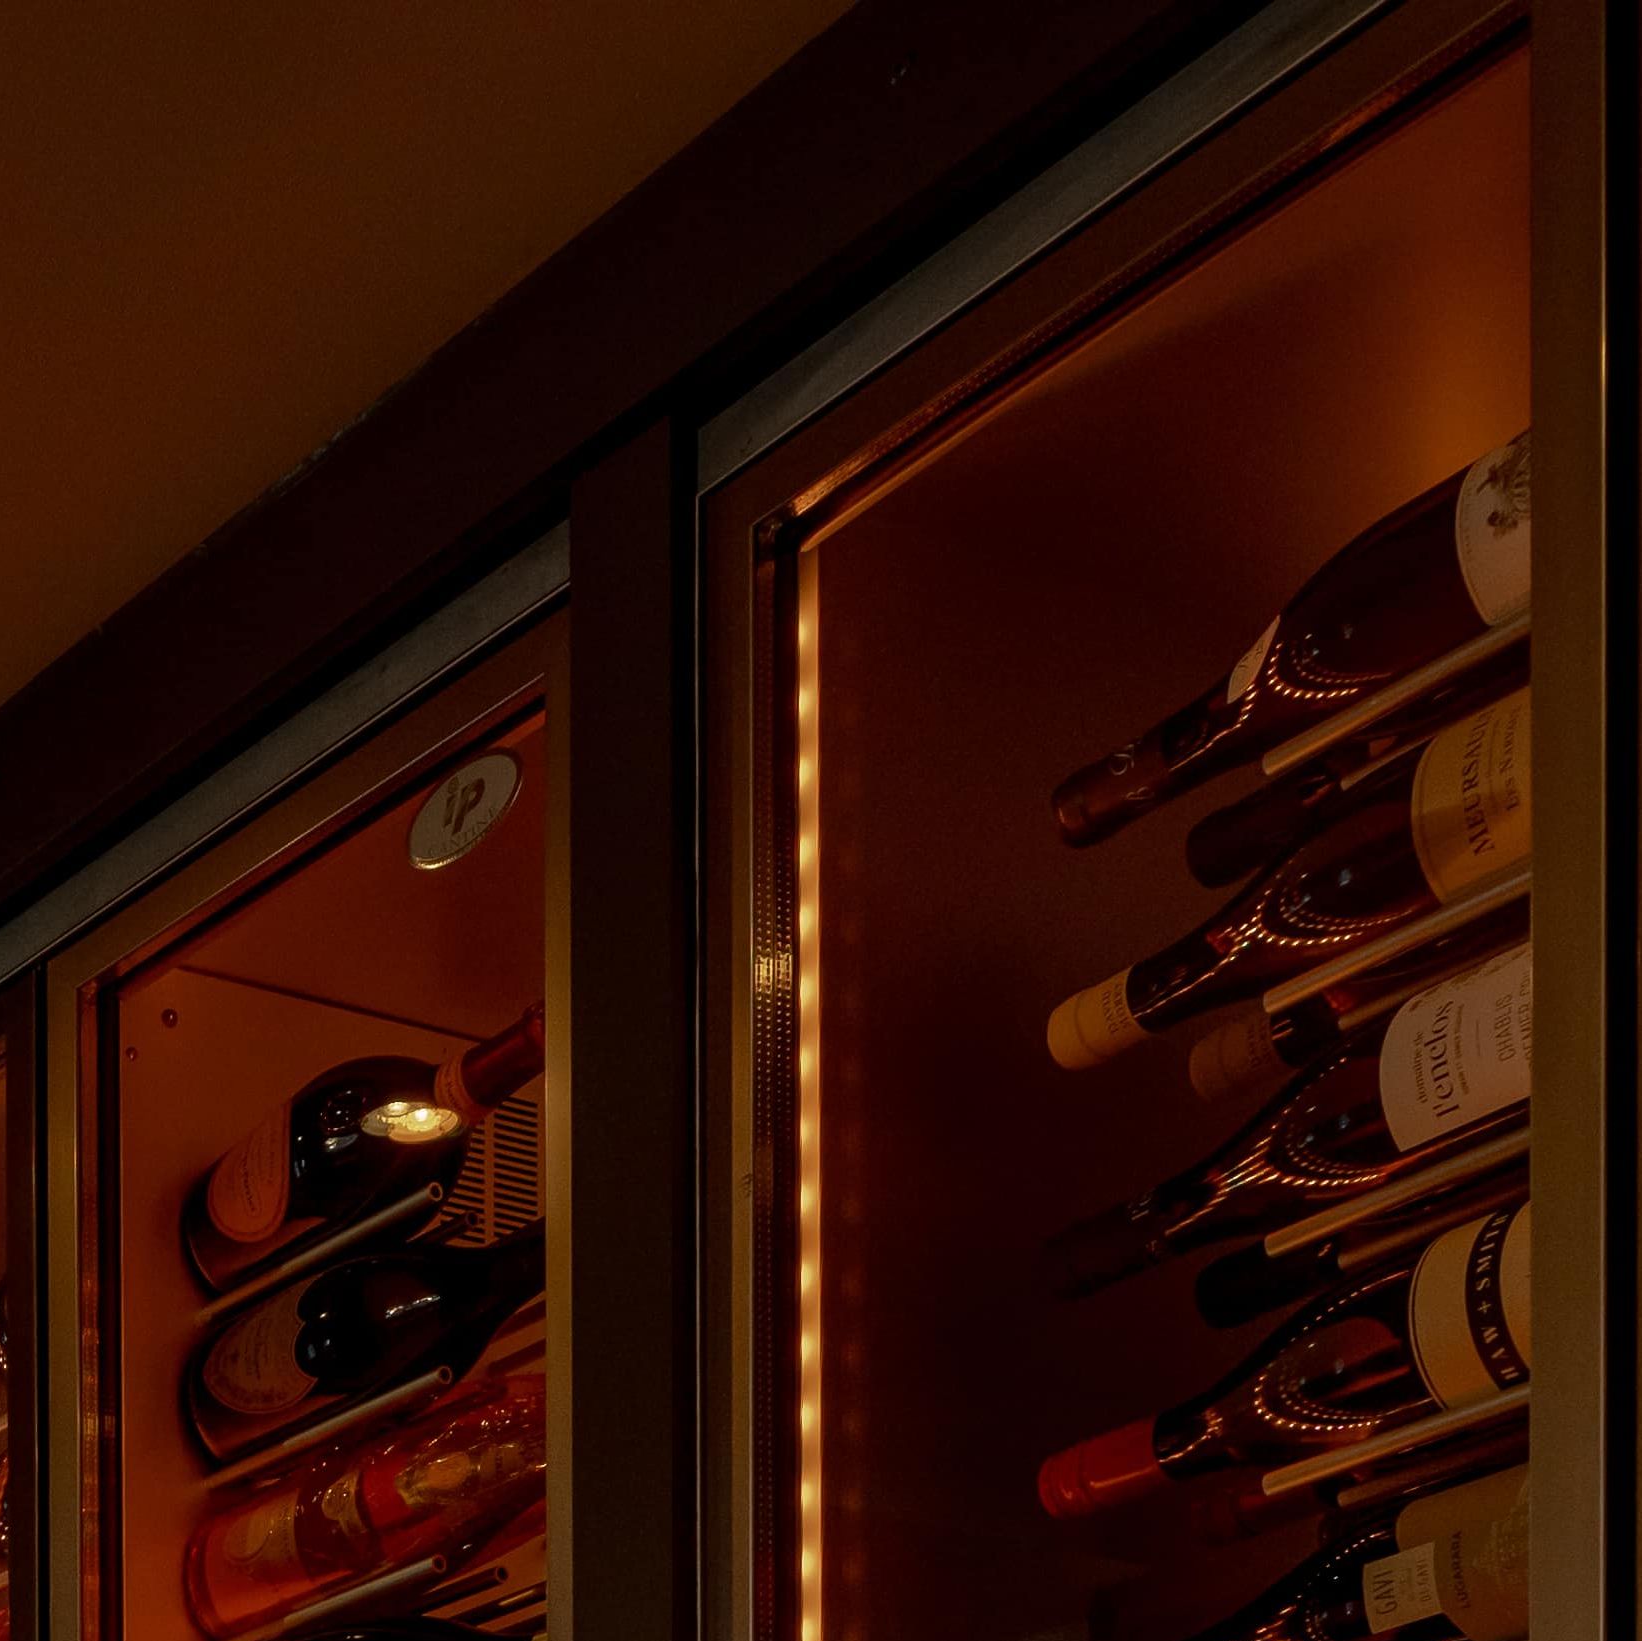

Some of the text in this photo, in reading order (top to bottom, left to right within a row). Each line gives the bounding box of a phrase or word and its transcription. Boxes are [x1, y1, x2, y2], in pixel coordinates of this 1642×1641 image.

[1423, 999, 1461, 1118] l'enclos
[1494, 994, 1517, 1062] CHABLIS
[1412, 1031, 1429, 1104] domaine de
[1475, 1213, 1510, 1289] SMITH
[1482, 1324, 1521, 1381] HAW
[1370, 1569, 1398, 1615] GAVI
